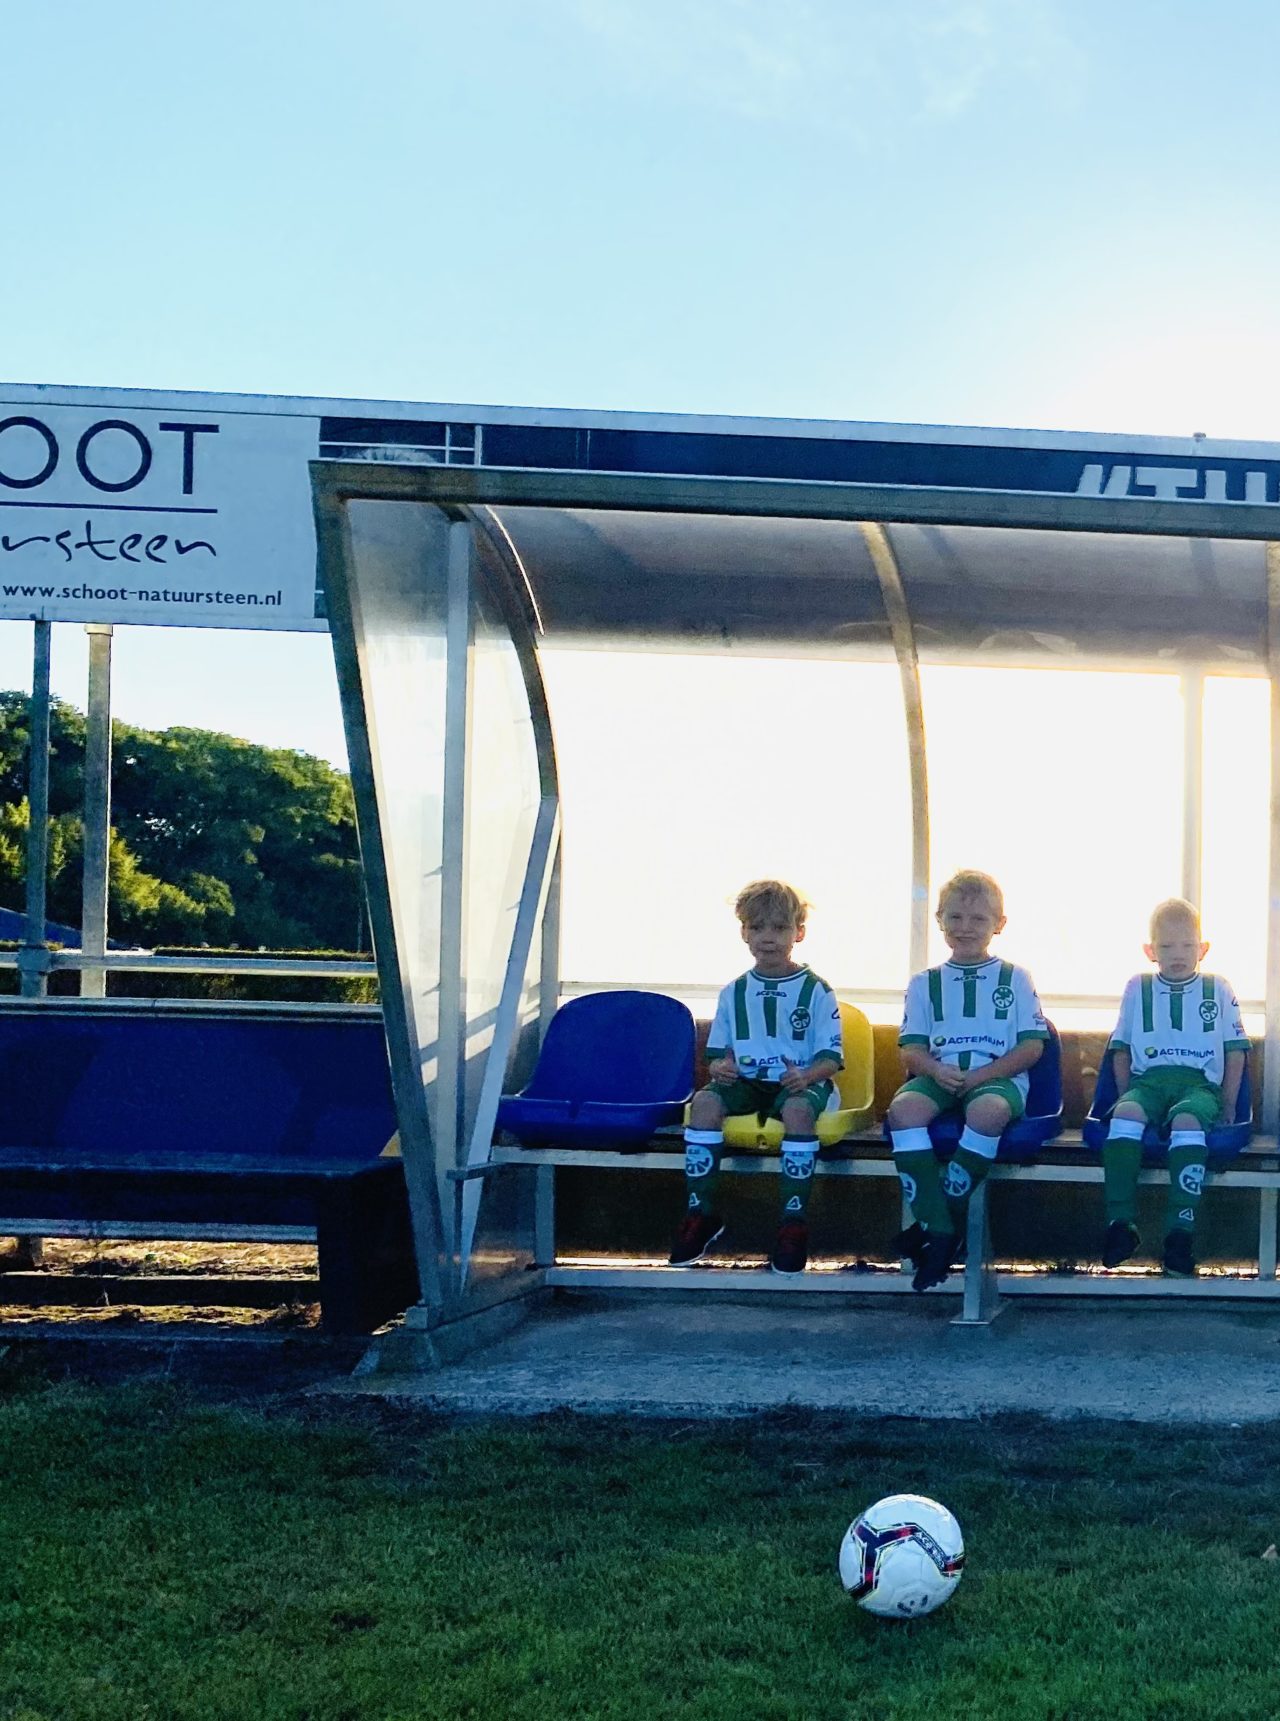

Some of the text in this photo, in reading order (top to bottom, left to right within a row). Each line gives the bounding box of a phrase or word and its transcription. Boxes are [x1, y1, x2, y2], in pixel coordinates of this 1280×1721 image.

[0, 415, 220, 495] OOT
[2, 582, 282, 606] www.schoot-natuursteen.nl
[947, 1035, 1006, 1048] ACTEMIUM
[1159, 1048, 1215, 1059] ACTEMIUM
